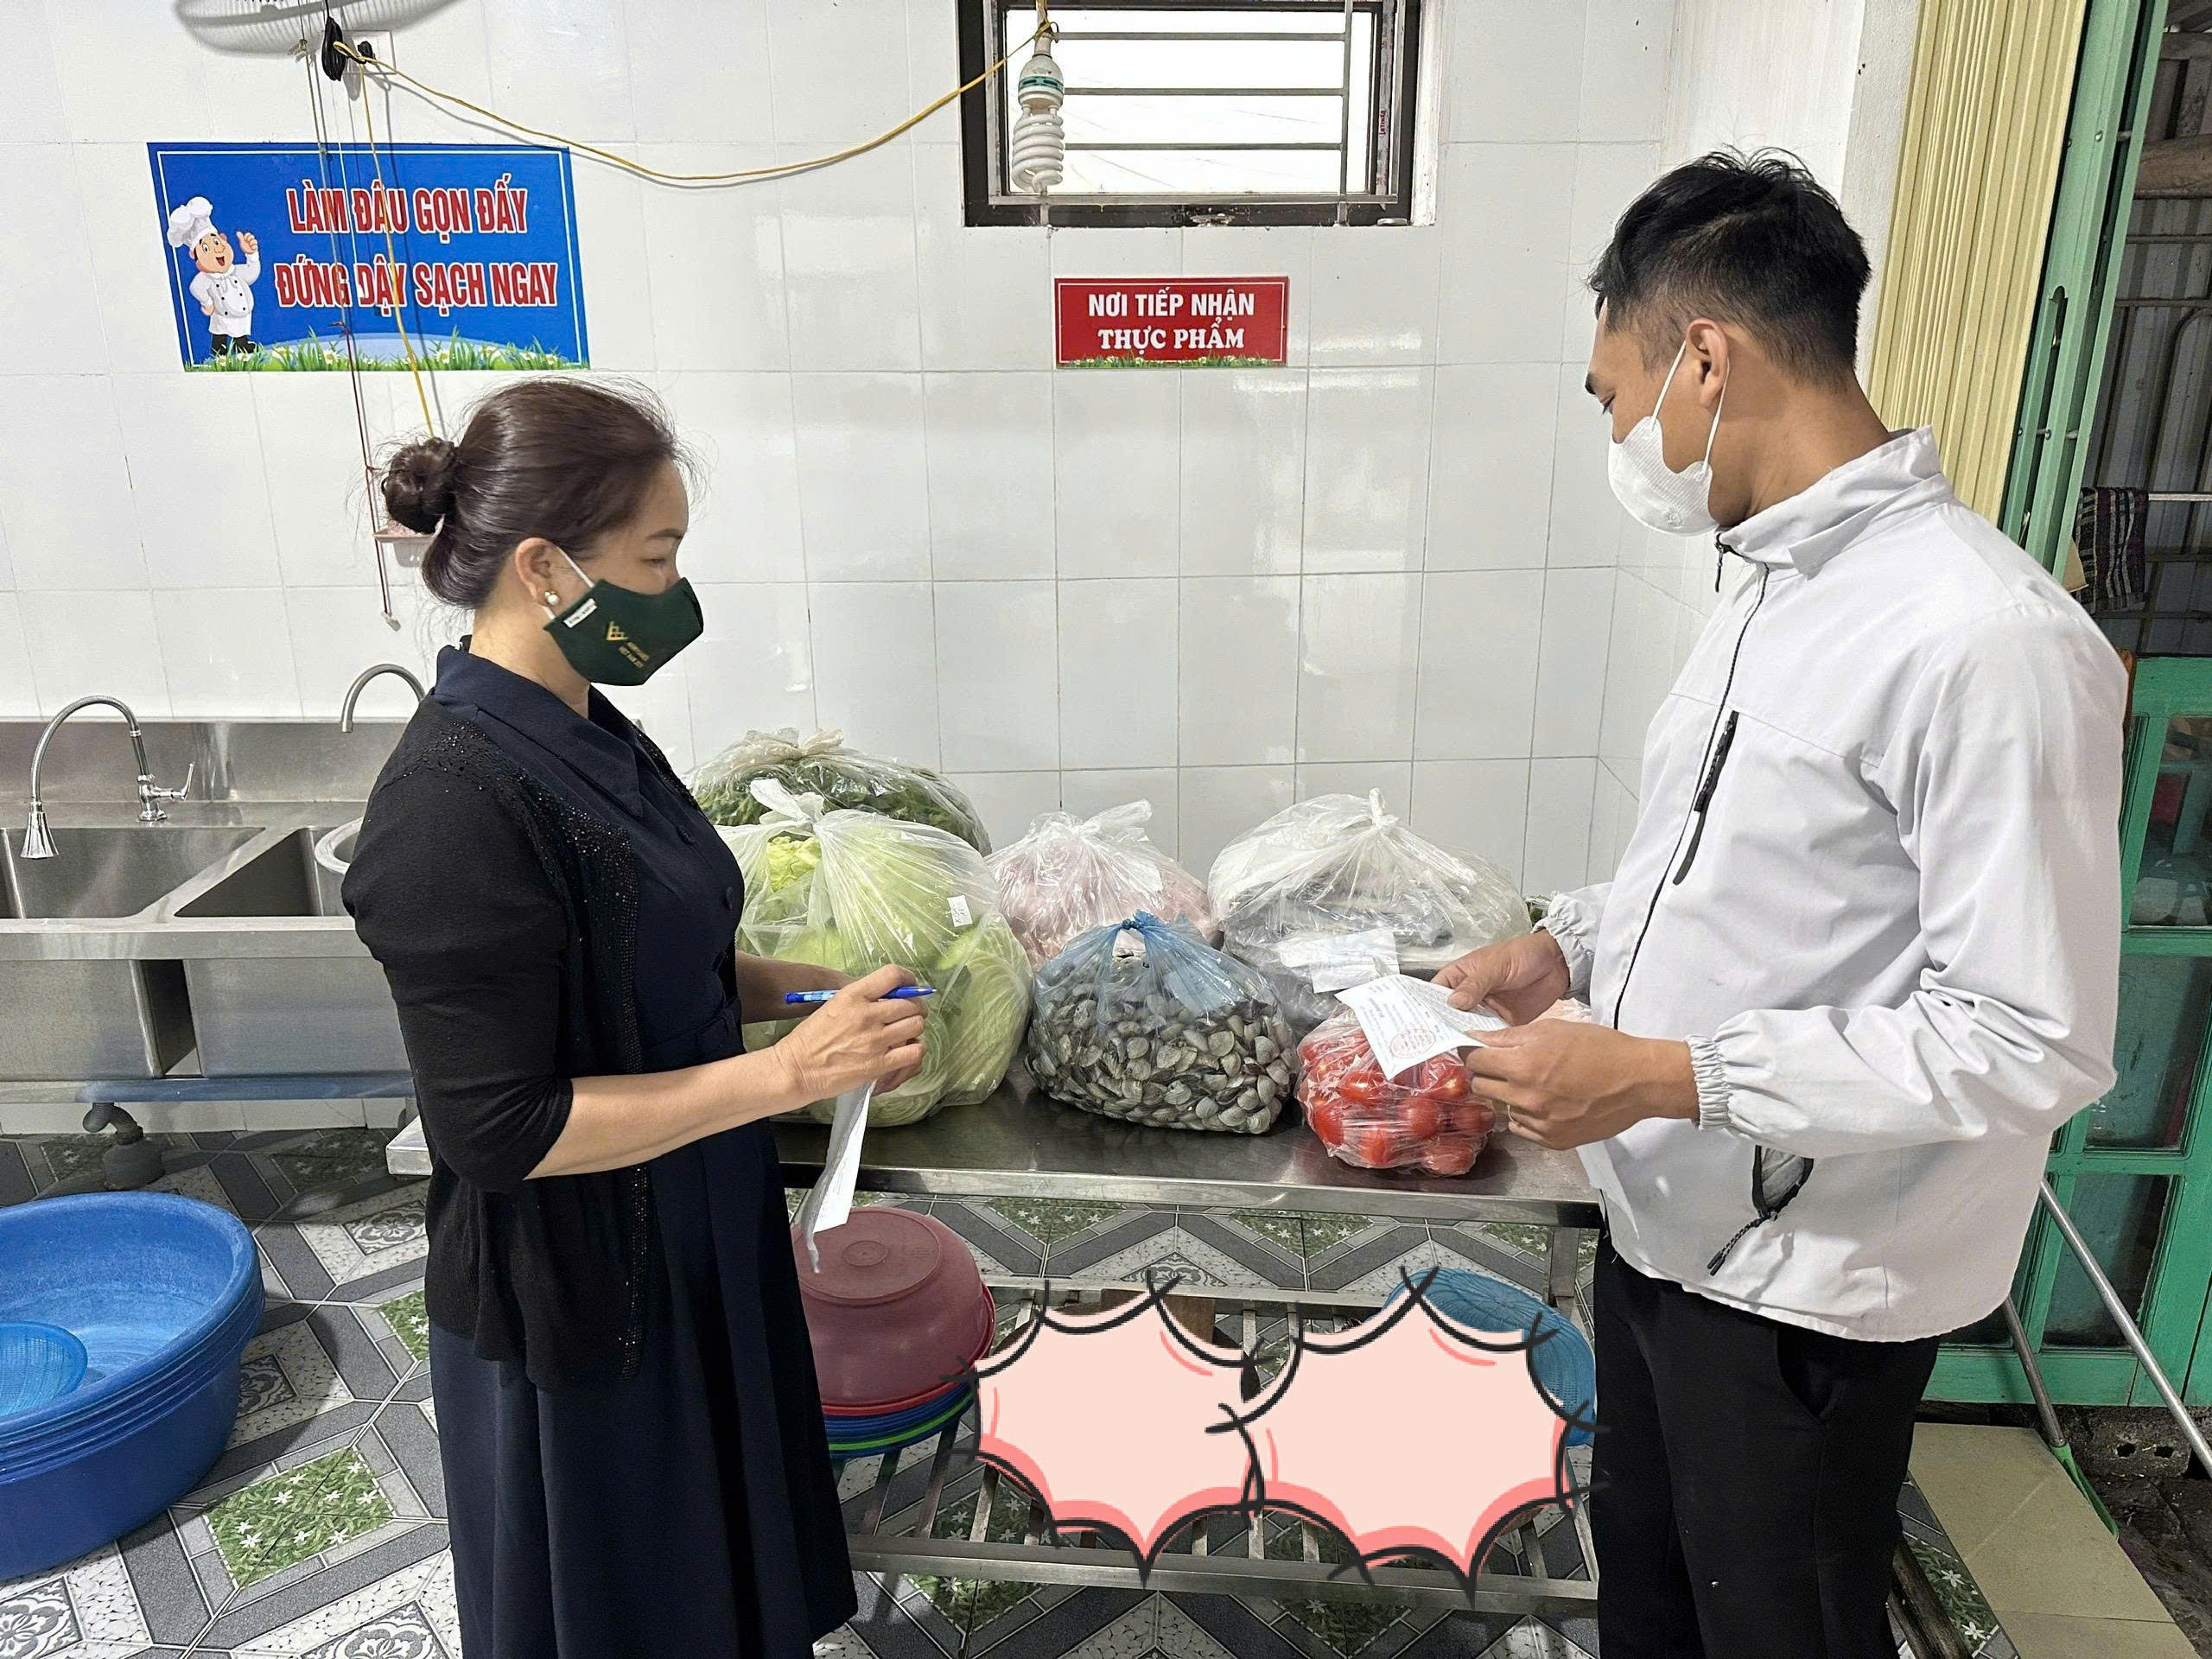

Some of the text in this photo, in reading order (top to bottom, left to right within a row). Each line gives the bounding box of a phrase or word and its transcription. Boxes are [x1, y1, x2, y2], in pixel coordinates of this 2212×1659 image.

[286, 173, 528, 245] LÀM ĐÂU GỌN ĐẤY
[274, 254, 558, 317] ĐỨNG DẬY SẠCH NGAY
[1088, 287, 1255, 321] NƠI TIẾP NHẬN
[1097, 317, 1245, 355] THỰC PHẨM
